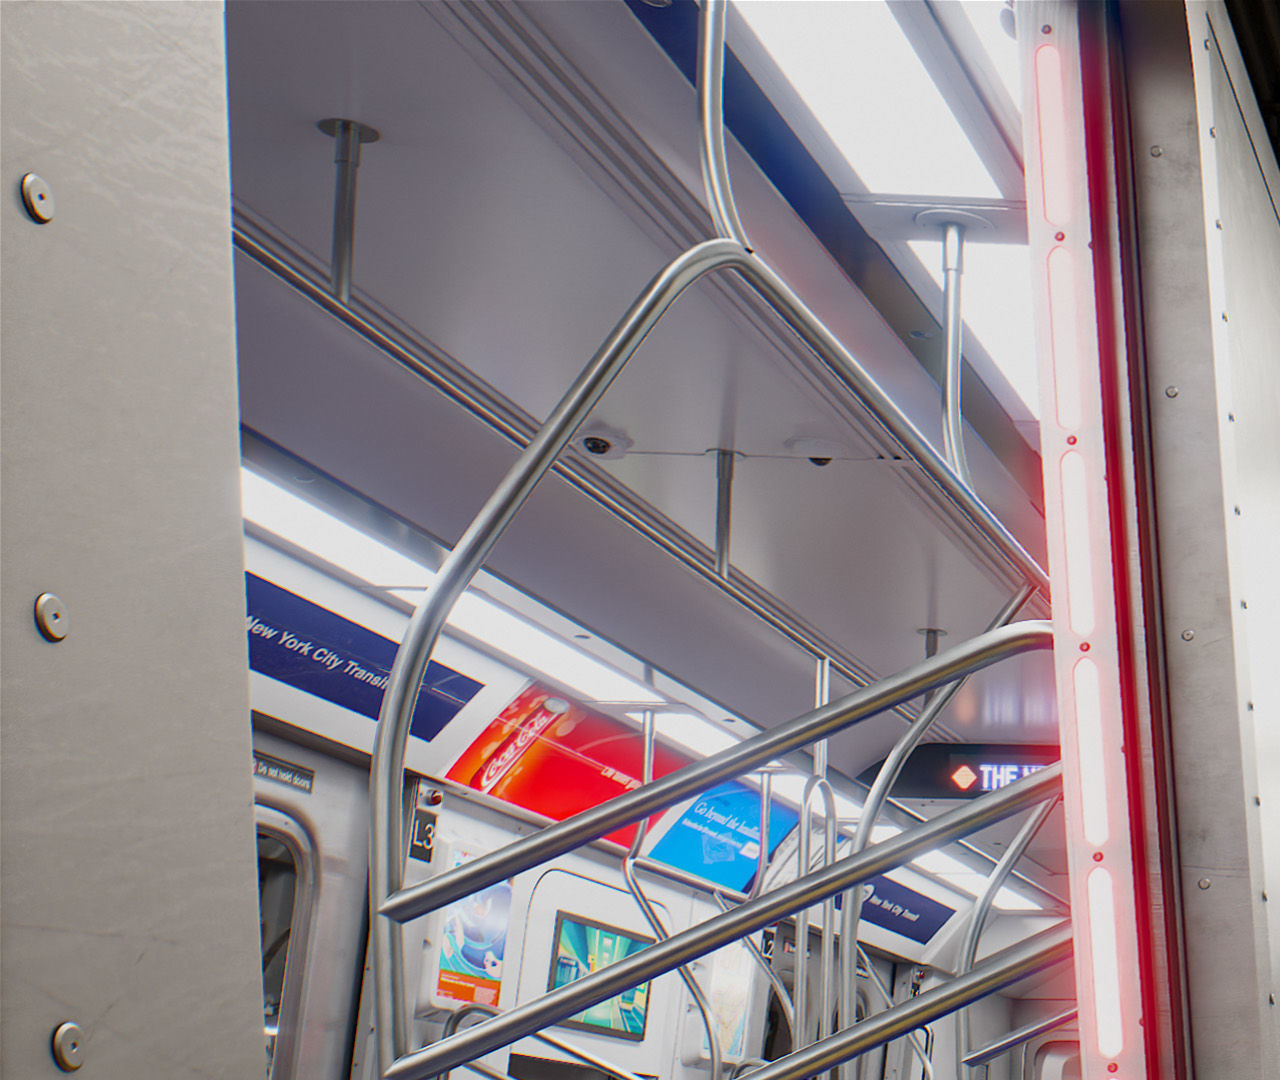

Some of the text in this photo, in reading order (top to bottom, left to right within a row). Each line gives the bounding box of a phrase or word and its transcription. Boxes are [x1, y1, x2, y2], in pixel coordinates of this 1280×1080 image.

[278, 631, 314, 656] York
[312, 648, 344, 670] City
[413, 820, 434, 850] L3
